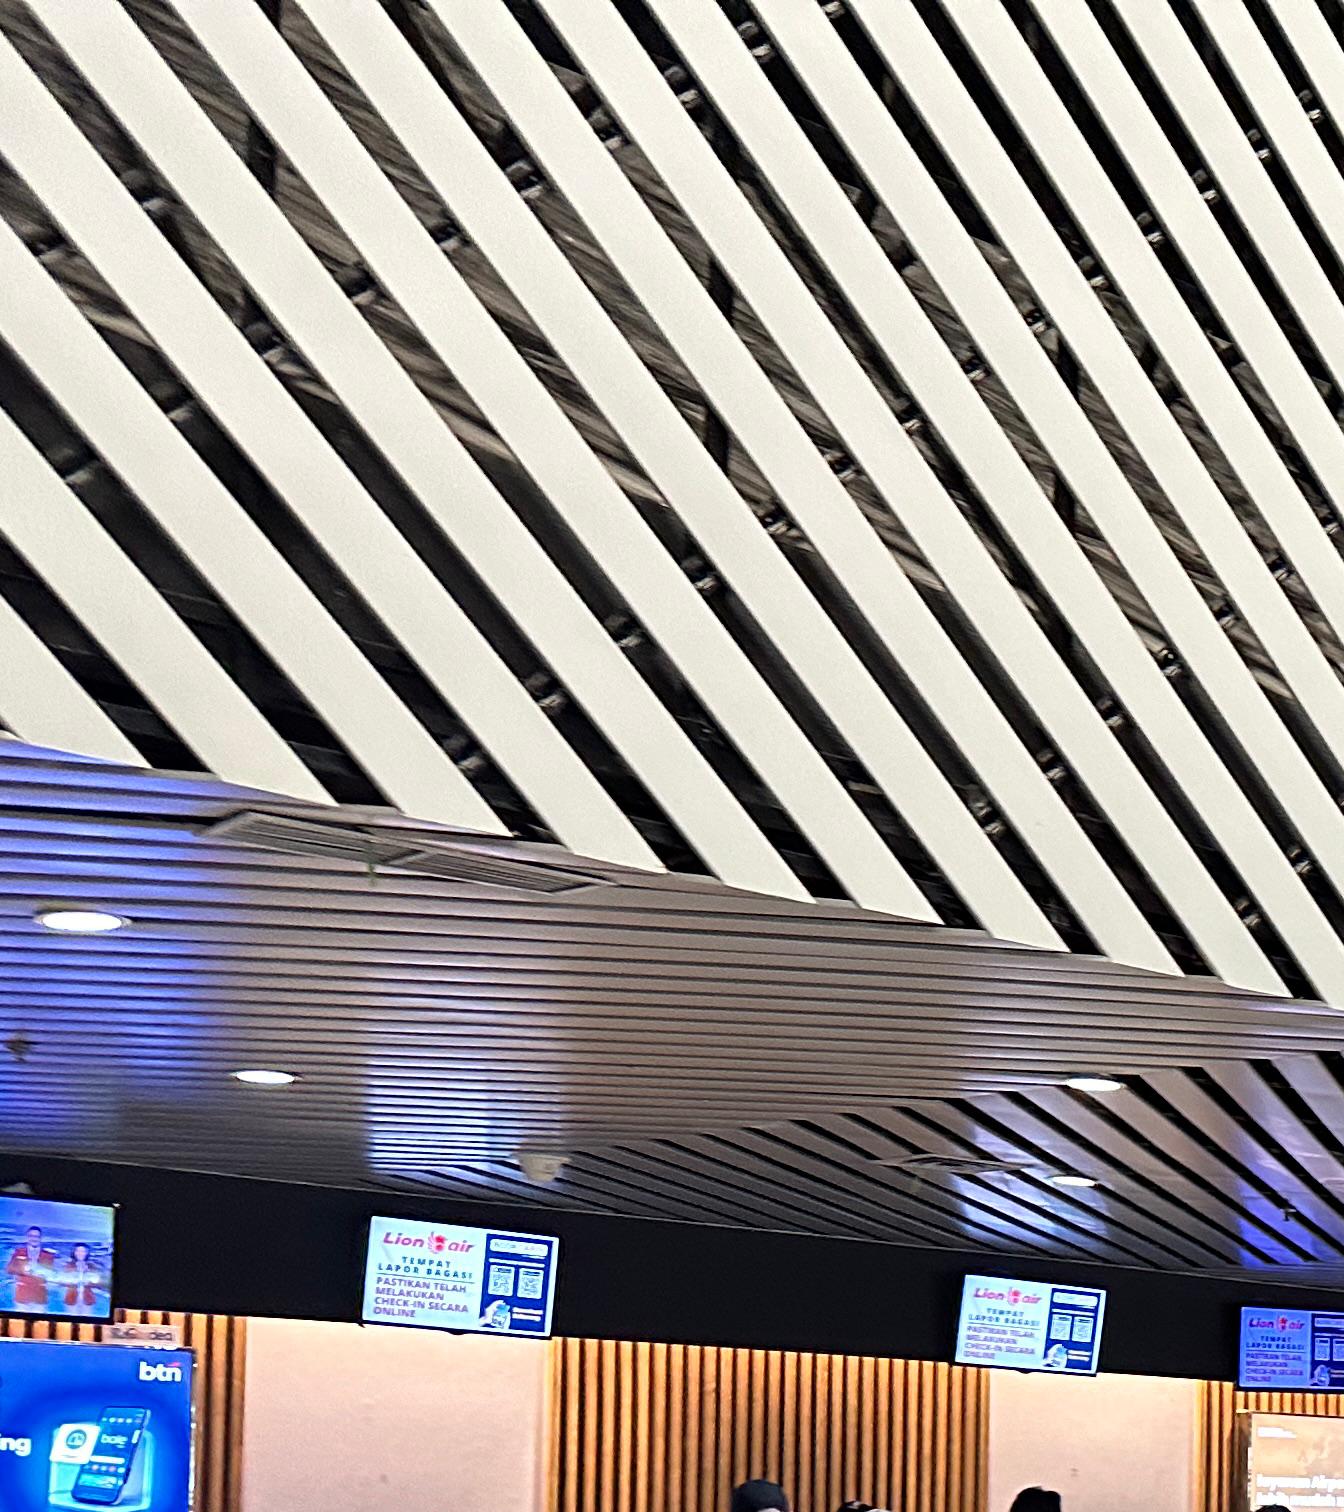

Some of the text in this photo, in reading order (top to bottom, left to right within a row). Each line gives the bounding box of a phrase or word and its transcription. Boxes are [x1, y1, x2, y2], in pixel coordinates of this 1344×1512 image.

[383, 1231, 475, 1253] Lion air
[378, 1263, 419, 1274] LAPOR
[401, 1256, 451, 1269] TEMPAT
[376, 1276, 467, 1294] PASTIKAN TELAH
[374, 1296, 426, 1309] CHECK-IN
